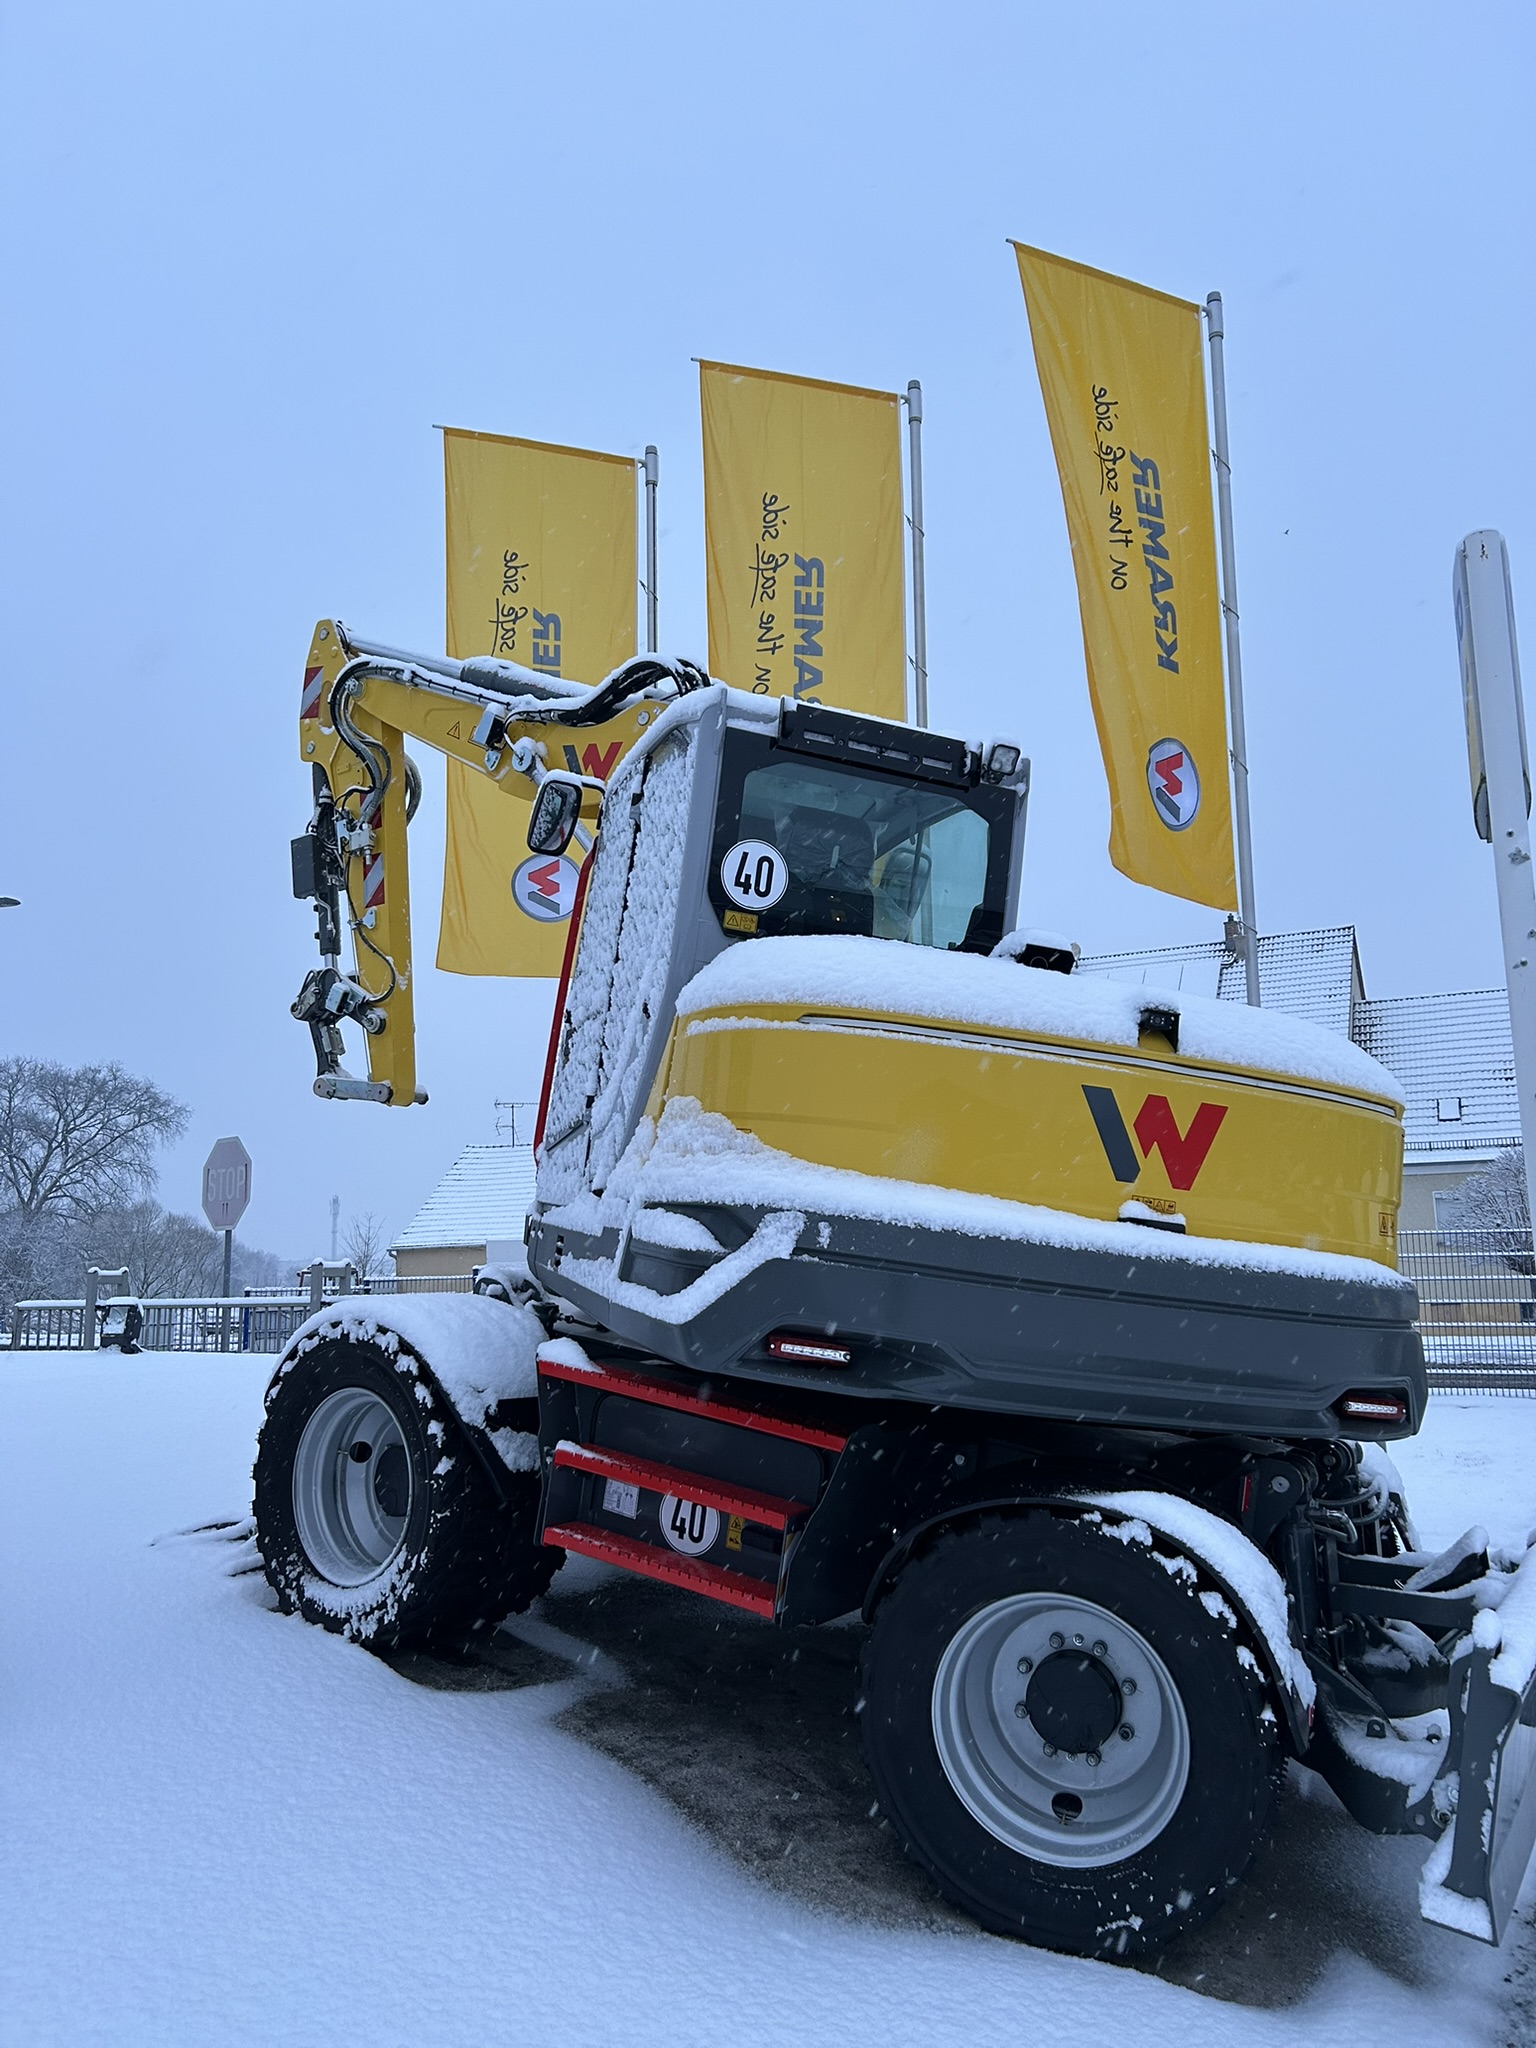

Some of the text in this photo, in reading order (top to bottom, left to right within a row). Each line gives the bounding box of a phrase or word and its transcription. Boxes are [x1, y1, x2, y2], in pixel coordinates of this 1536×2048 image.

[733, 851, 775, 898] 40
[207, 1165, 246, 1202] STOP
[670, 1498, 708, 1544] 40
